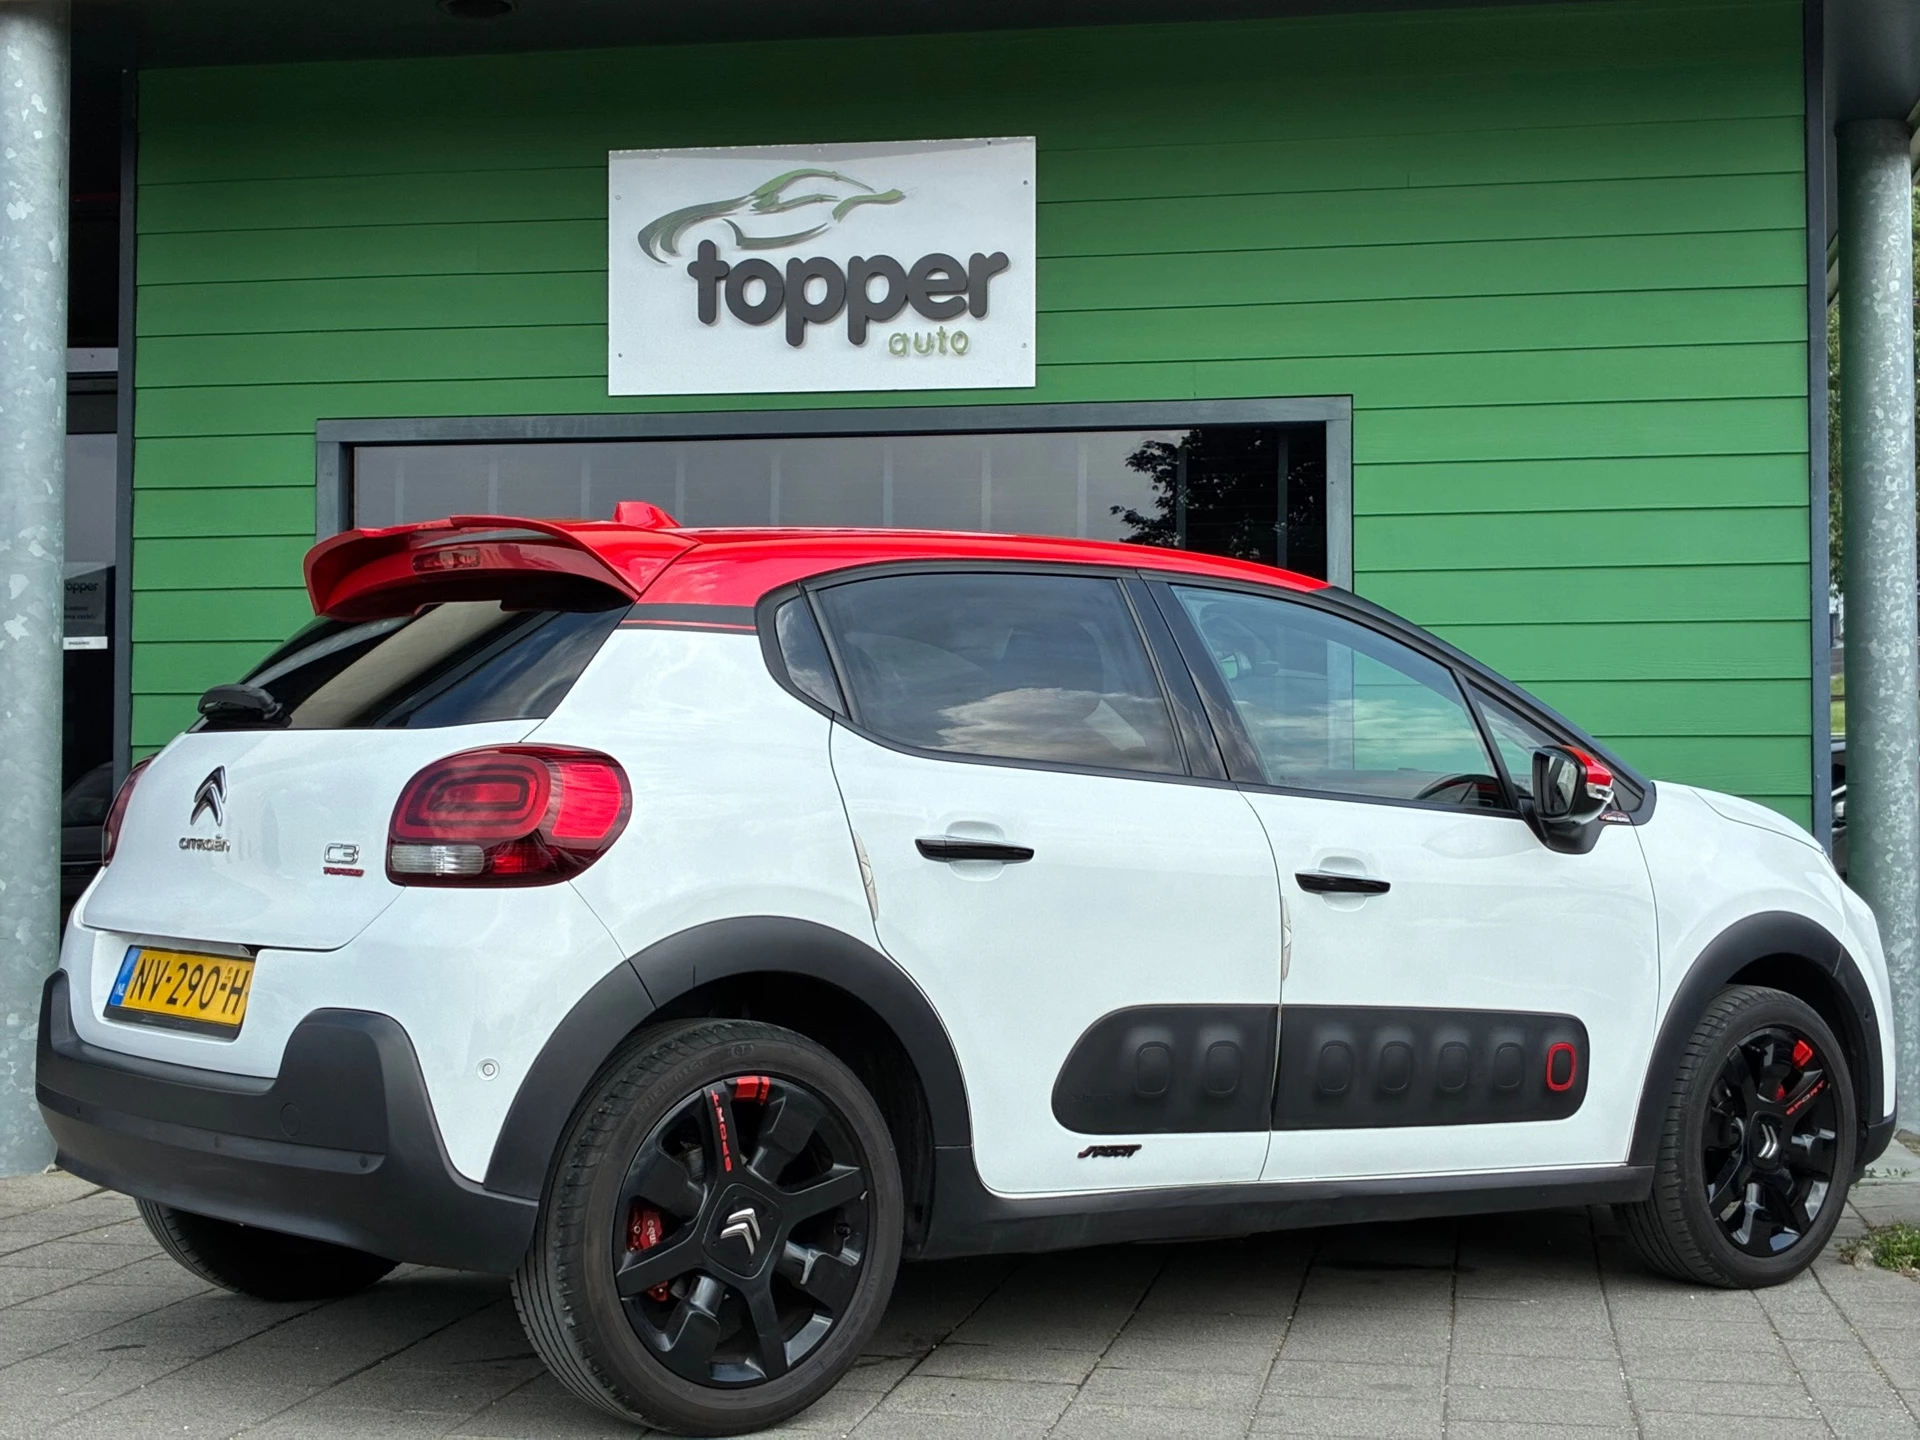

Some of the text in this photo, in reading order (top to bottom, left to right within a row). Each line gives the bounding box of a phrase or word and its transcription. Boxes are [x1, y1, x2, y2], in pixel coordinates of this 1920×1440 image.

[687, 239, 1010, 346] topper
[888, 325, 969, 356] auto
[64, 581, 99, 594] opper
[324, 843, 360, 865] C3
[129, 958, 251, 1015] NV-290-H
